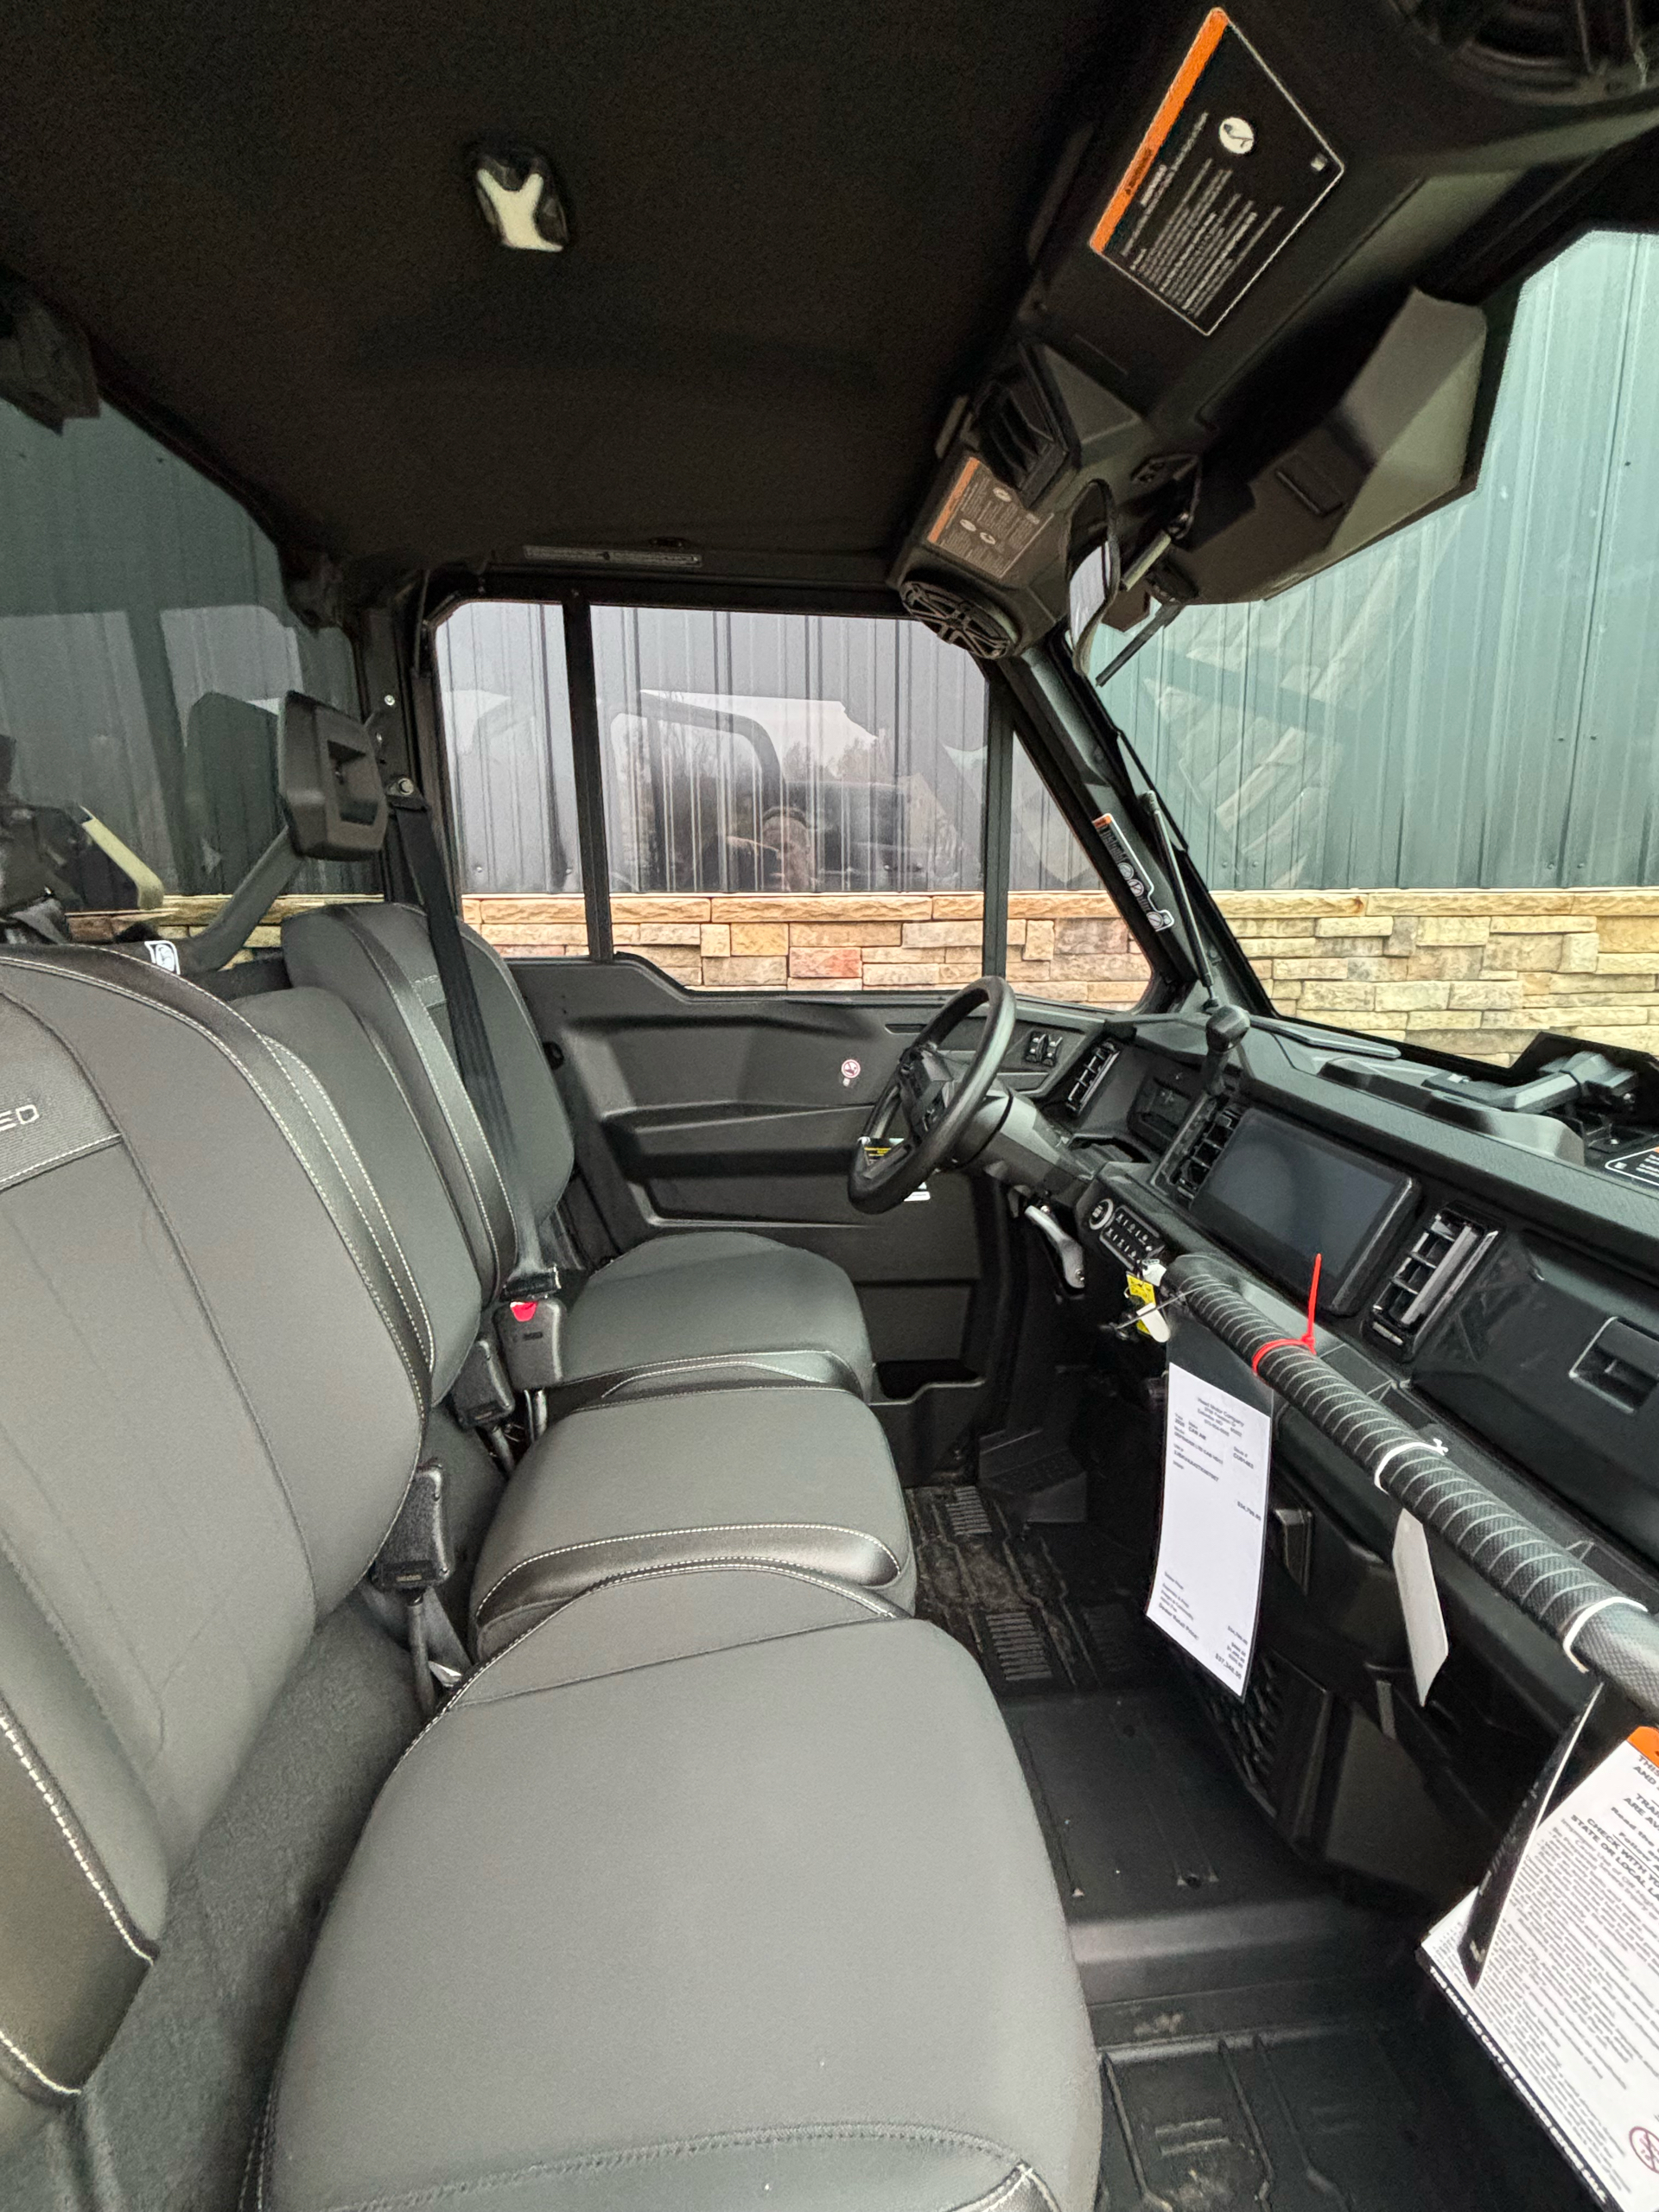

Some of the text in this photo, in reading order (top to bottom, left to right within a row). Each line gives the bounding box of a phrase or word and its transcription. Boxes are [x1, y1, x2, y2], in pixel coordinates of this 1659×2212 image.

[1223, 1410, 1244, 1427] Company
[1173, 1614, 1185, 1628] Retail
[1632, 1764, 1656, 1786] AND
[1623, 1796, 1644, 1815] ARE
[1610, 1806, 1655, 1848] Read the
[1569, 1814, 1600, 1844] STATE
[1599, 1841, 1616, 1858] OR
[1614, 1855, 1648, 1888] LOCAL
[1586, 1816, 1621, 1850] CHECK
[1619, 1848, 1647, 1875] WITH
[1618, 1831, 1652, 1863] Follow
[1428, 1965, 1448, 1989] THIS
[1445, 1986, 1469, 2016] HANG
[1465, 2014, 1484, 2035] TAG
[1501, 2063, 1516, 2079] BE
[1512, 2077, 1553, 2128] REMOVED
[1548, 2126, 1584, 2170] BEFORE
